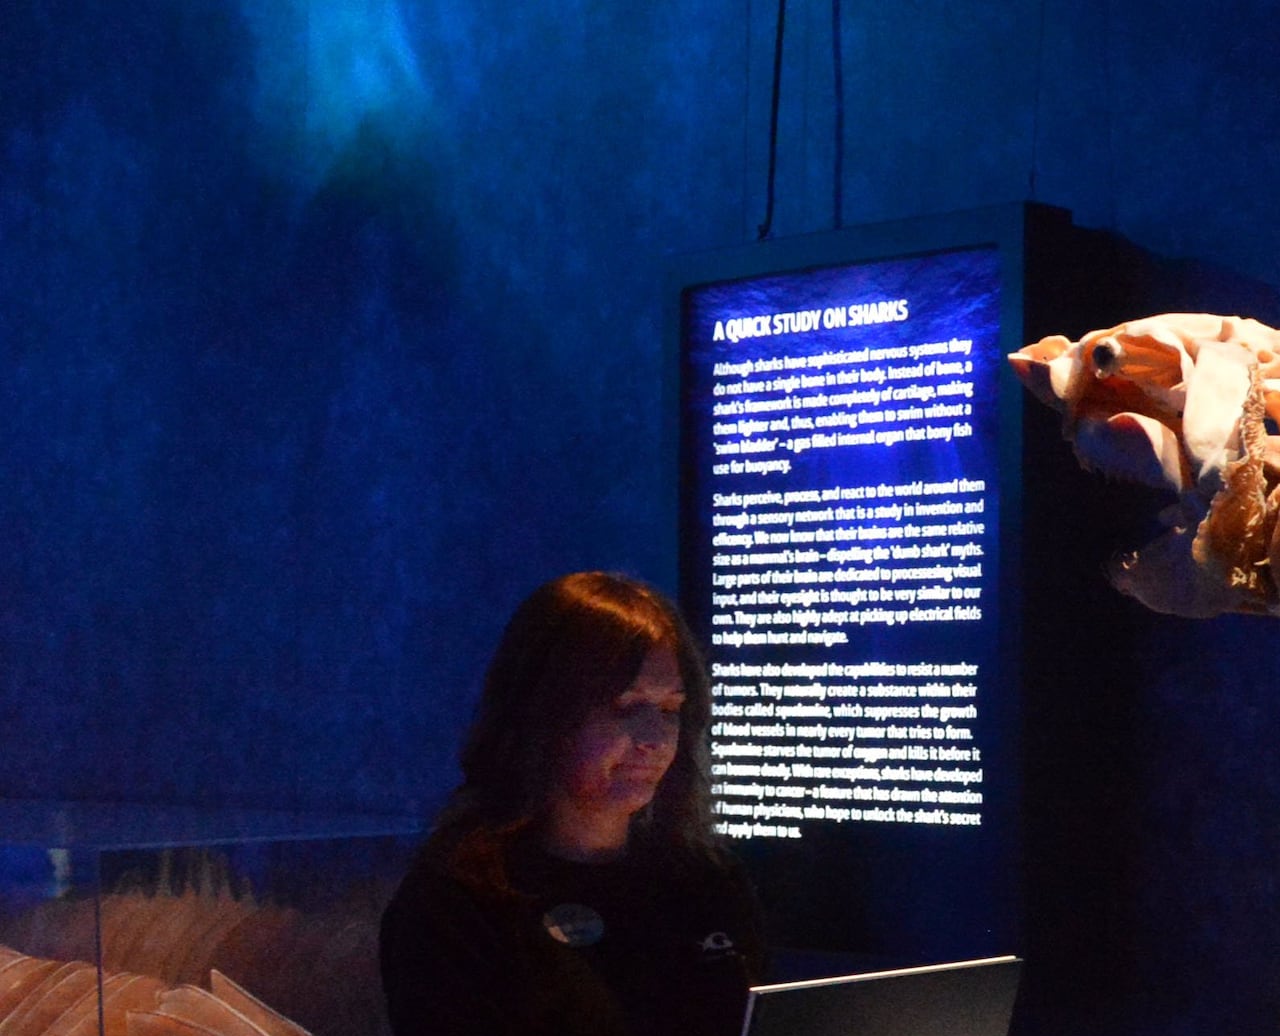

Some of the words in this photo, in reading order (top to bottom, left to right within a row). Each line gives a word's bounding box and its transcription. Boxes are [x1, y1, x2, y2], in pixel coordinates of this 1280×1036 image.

[712, 320, 725, 341] A
[725, 314, 772, 343] QUICK
[772, 309, 822, 335] STUDY
[822, 306, 847, 329] ON
[847, 299, 908, 327] SHARKS
[713, 359, 754, 377] Although
[754, 356, 784, 373] sharks
[783, 355, 807, 369] have
[948, 337, 972, 355] they
[713, 382, 726, 396] do
[725, 382, 743, 395] not
[742, 379, 765, 393] have
[764, 380, 772, 392] a
[825, 371, 837, 386] in
[859, 366, 887, 385] body.
[887, 362, 924, 380] Instead
[923, 360, 936, 377] of
[964, 360, 973, 373] a
[713, 400, 744, 416] shark's
[792, 395, 802, 409] is
[801, 392, 828, 408] made
[828, 387, 881, 408] completely
[880, 385, 892, 402] of
[891, 384, 937, 402] cartilage,
[936, 380, 974, 398] making
[769, 416, 790, 431] and,
[790, 415, 814, 429] thus,
[884, 409, 897, 422] to
[896, 405, 923, 421] swim
[923, 402, 964, 418] without
[964, 403, 972, 415] a
[785, 438, 794, 450] a
[793, 437, 811, 453] gas
[904, 426, 926, 441] that
[926, 425, 953, 442] bony
[952, 422, 972, 437] fish
[713, 463, 730, 475] use
[729, 459, 745, 474] for
[744, 459, 792, 475] buoyancy.
[712, 492, 743, 507] Sharks
[820, 485, 840, 501] and
[840, 486, 865, 500] react
[864, 486, 877, 498] to
[876, 483, 894, 498] the
[894, 480, 923, 496] world
[922, 478, 959, 495] around
[712, 511, 750, 529] through
[749, 513, 757, 525] a
[757, 512, 795, 527] sensory
[794, 507, 834, 522] network
[834, 506, 856, 521] that
[855, 505, 866, 520] is
[865, 507, 874, 519] a
[902, 502, 914, 516] in
[915, 500, 963, 516] invention
[964, 498, 984, 514] and
[769, 532, 790, 544] now
[815, 527, 835, 542] that
[903, 523, 921, 538] the
[920, 524, 948, 537] same
[947, 520, 985, 536] relative
[950, 541, 984, 560] myths.
[712, 572, 737, 589] Large
[736, 573, 761, 588] parts
[760, 570, 771, 584] of
[891, 564, 953, 583] processing
[952, 562, 982, 578] visual
[738, 590, 757, 605] and
[819, 588, 830, 603] is
[829, 587, 868, 606] thought
[867, 589, 880, 602] to
[879, 586, 894, 601] be
[893, 589, 916, 604] very
[950, 586, 963, 599] to
[963, 587, 982, 599] our
[712, 613, 734, 625] own.
[734, 610, 757, 628] They
[756, 613, 772, 624] are
[772, 610, 792, 624] also
[859, 607, 895, 626] picking
[894, 610, 909, 625] up
[908, 605, 954, 621] electrical
[953, 605, 982, 620] fields
[712, 633, 722, 645] to
[788, 629, 807, 644] and
